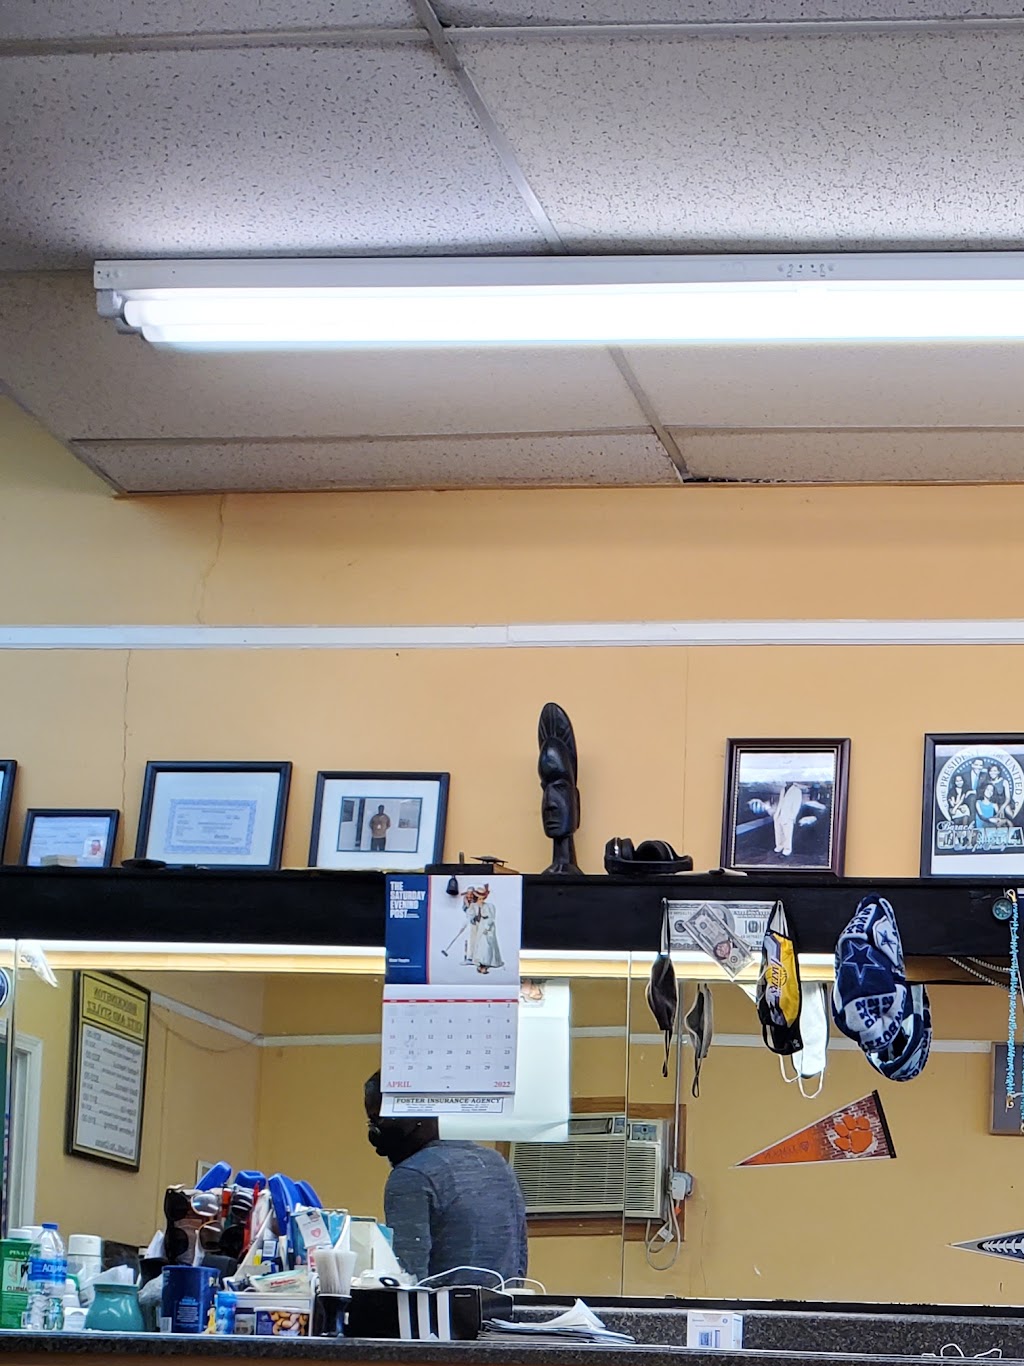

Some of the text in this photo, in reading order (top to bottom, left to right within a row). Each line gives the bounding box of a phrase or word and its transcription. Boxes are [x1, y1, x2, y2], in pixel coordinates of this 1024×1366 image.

[1004, 758, 1023, 796] UNITED
[937, 820, 976, 831] Barack
[389, 881, 404, 891] THE
[389, 890, 426, 901] SATURDAY
[389, 900, 419, 909] EVENING
[389, 909, 408, 919] POST
